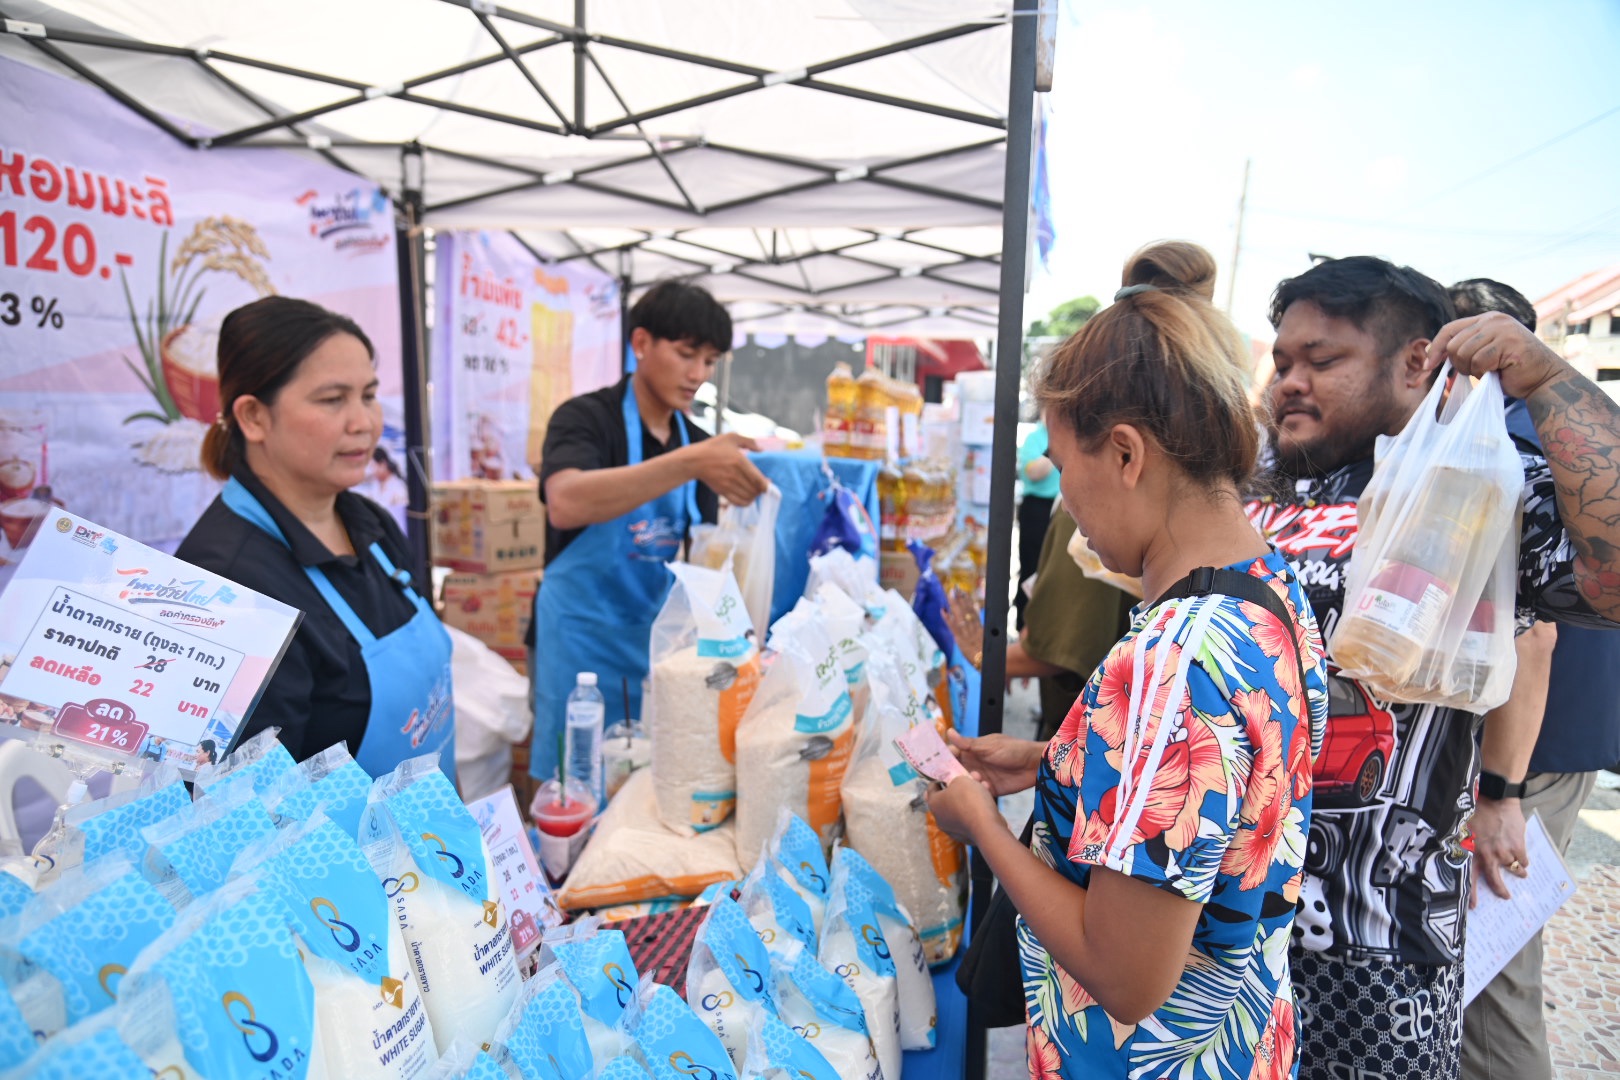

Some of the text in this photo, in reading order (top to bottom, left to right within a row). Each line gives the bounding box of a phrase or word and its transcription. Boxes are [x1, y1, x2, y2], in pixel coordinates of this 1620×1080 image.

[52, 594, 142, 641] น้ำตาลทราย
[43, 626, 122, 662] ราคาปกติ
[192, 676, 221, 694] บาท
[29, 654, 209, 719] ลดเหลือ 22 บาท
[95, 702, 124, 721] ลด
[396, 897, 408, 930] SADA
[479, 952, 503, 976] WHITE
[379, 1035, 409, 1067] WHITE
